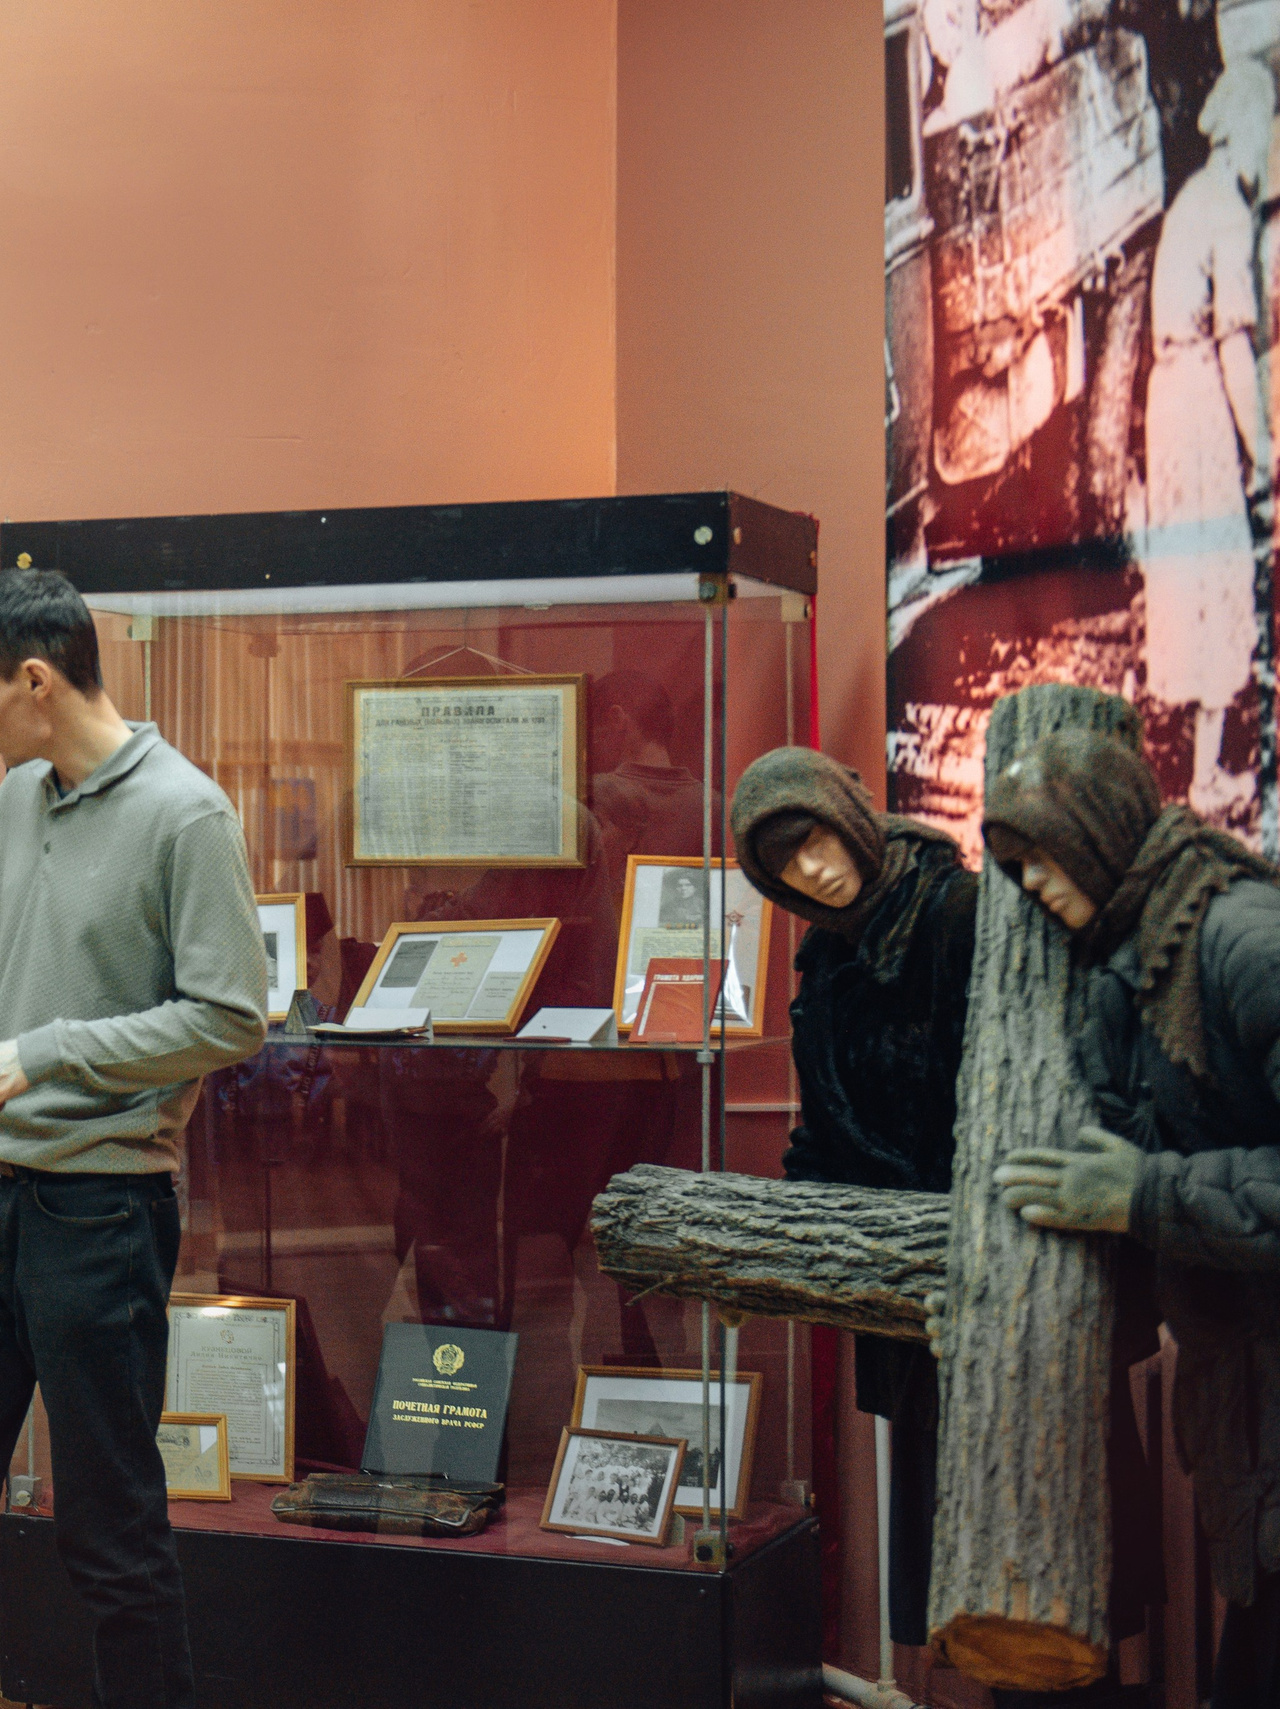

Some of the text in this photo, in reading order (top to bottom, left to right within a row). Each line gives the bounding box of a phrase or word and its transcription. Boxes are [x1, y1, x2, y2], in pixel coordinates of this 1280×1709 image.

[421, 705, 495, 717] ПРАВИЛА
[392, 1400, 488, 1419] ПОЧЕТНАЯ ГРАМОТА
[392, 1414, 485, 1429] ЗАСЛУЖЕННОГО ВРАЧА РСФСР
